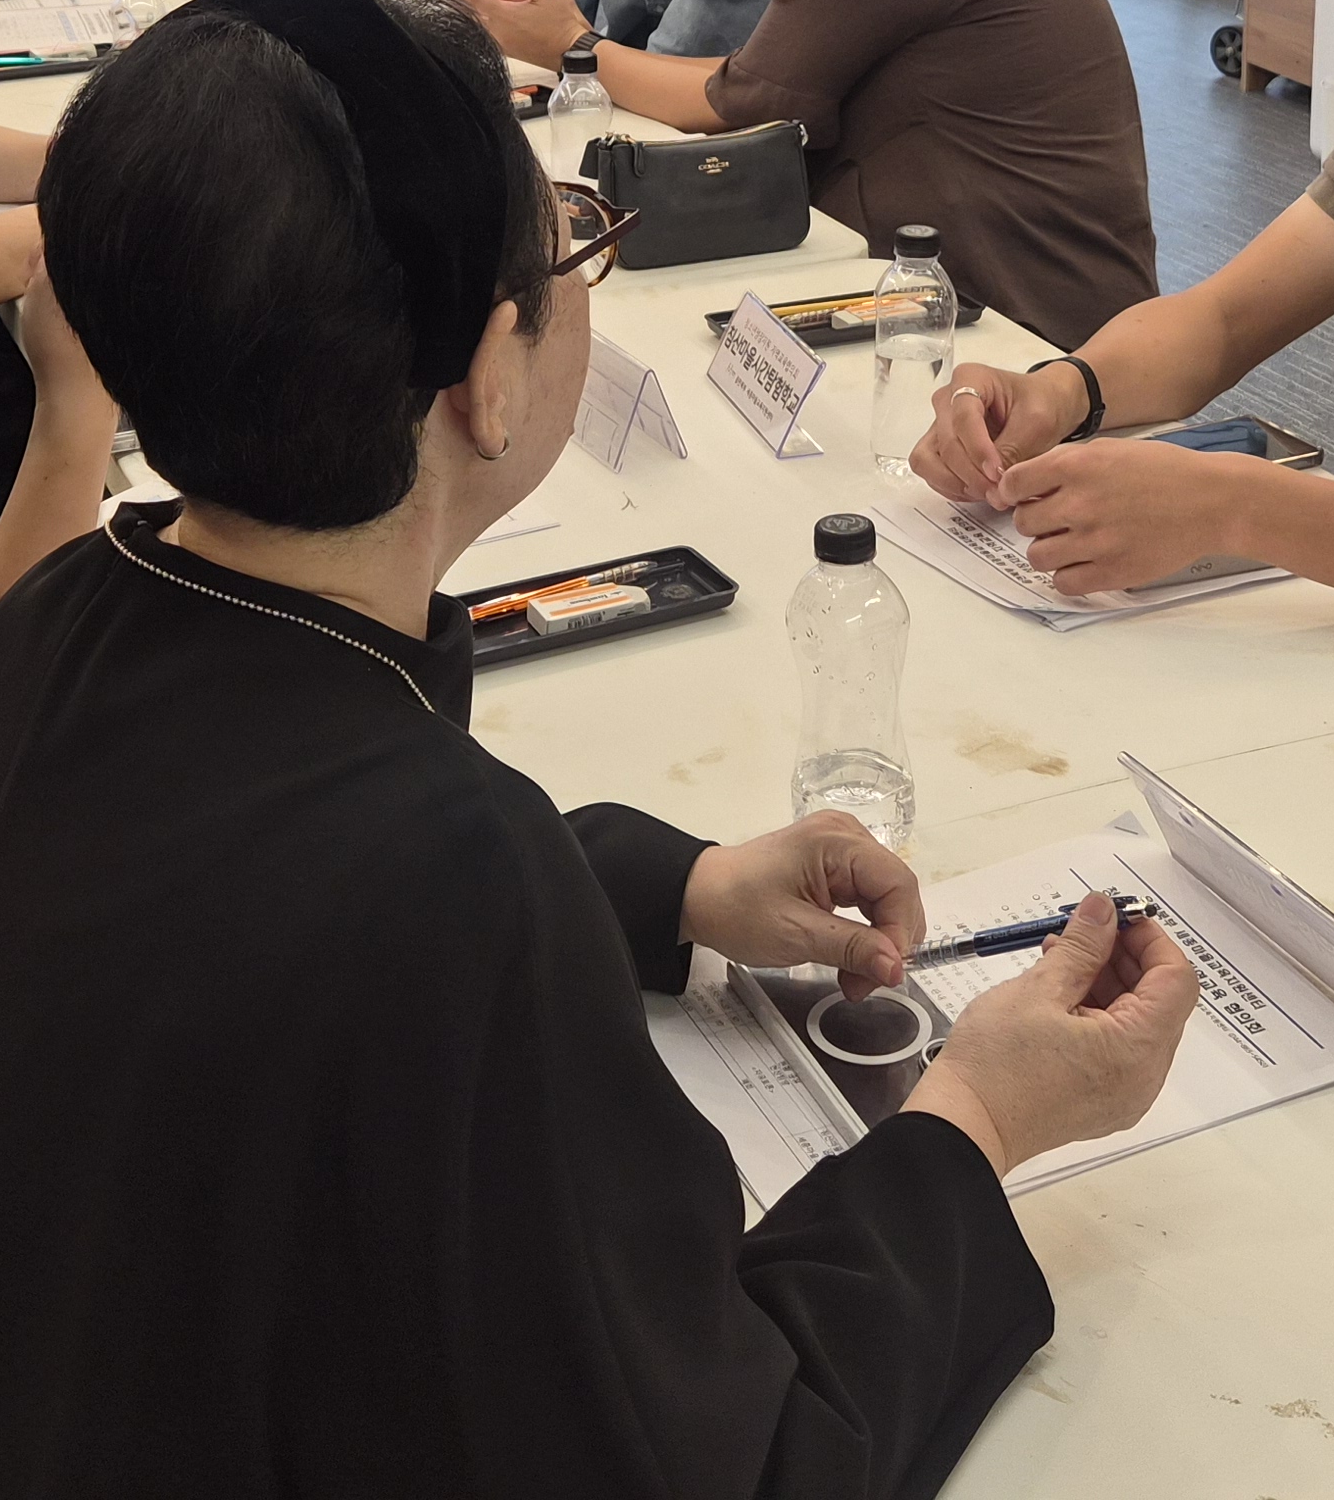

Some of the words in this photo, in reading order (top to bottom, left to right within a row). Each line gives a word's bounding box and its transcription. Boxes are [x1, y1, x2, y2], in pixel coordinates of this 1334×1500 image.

[725, 323, 799, 416] 침산마을시간탐험학교
[971, 531, 1005, 552] 지역교육
[1174, 928, 1265, 1010] 세종마을교육지원센터
[1225, 1001, 1265, 1036] 협의회
